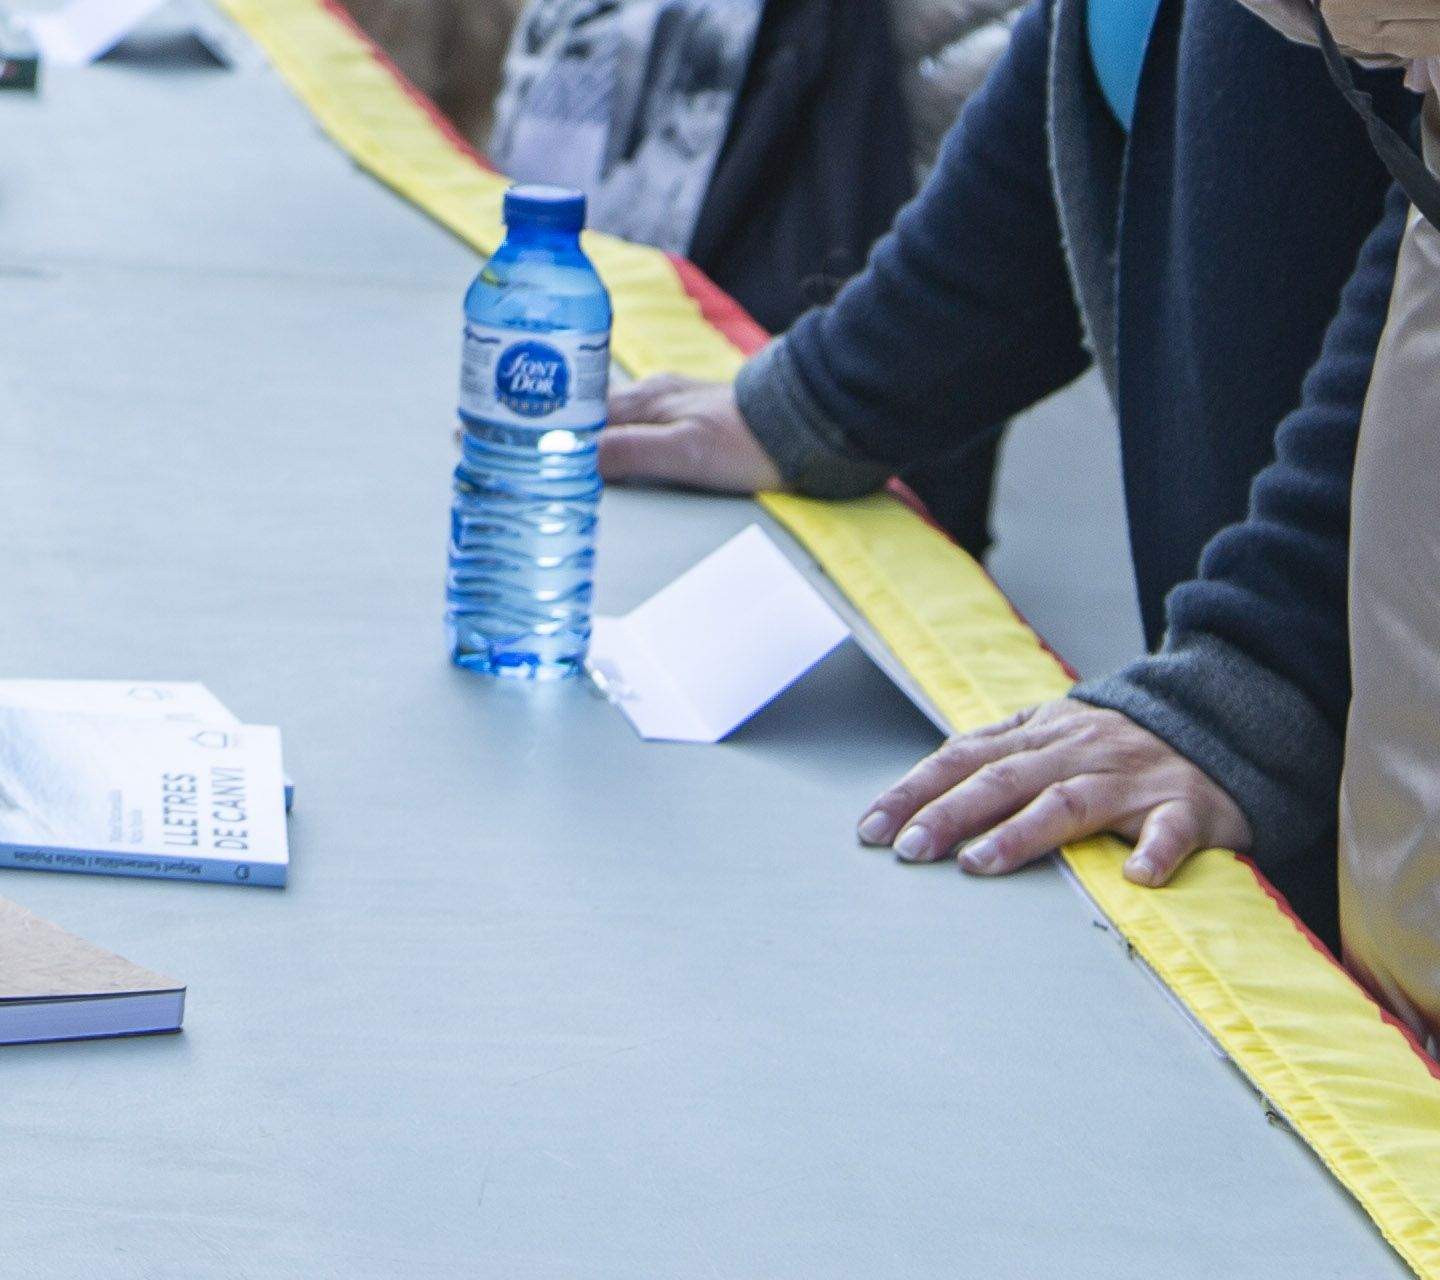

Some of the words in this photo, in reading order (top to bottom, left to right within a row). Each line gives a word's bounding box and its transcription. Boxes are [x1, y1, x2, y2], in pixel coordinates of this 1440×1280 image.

[163, 772, 199, 847] LLETRES
[211, 766, 248, 823] CANVI
[213, 827, 249, 851] DE
